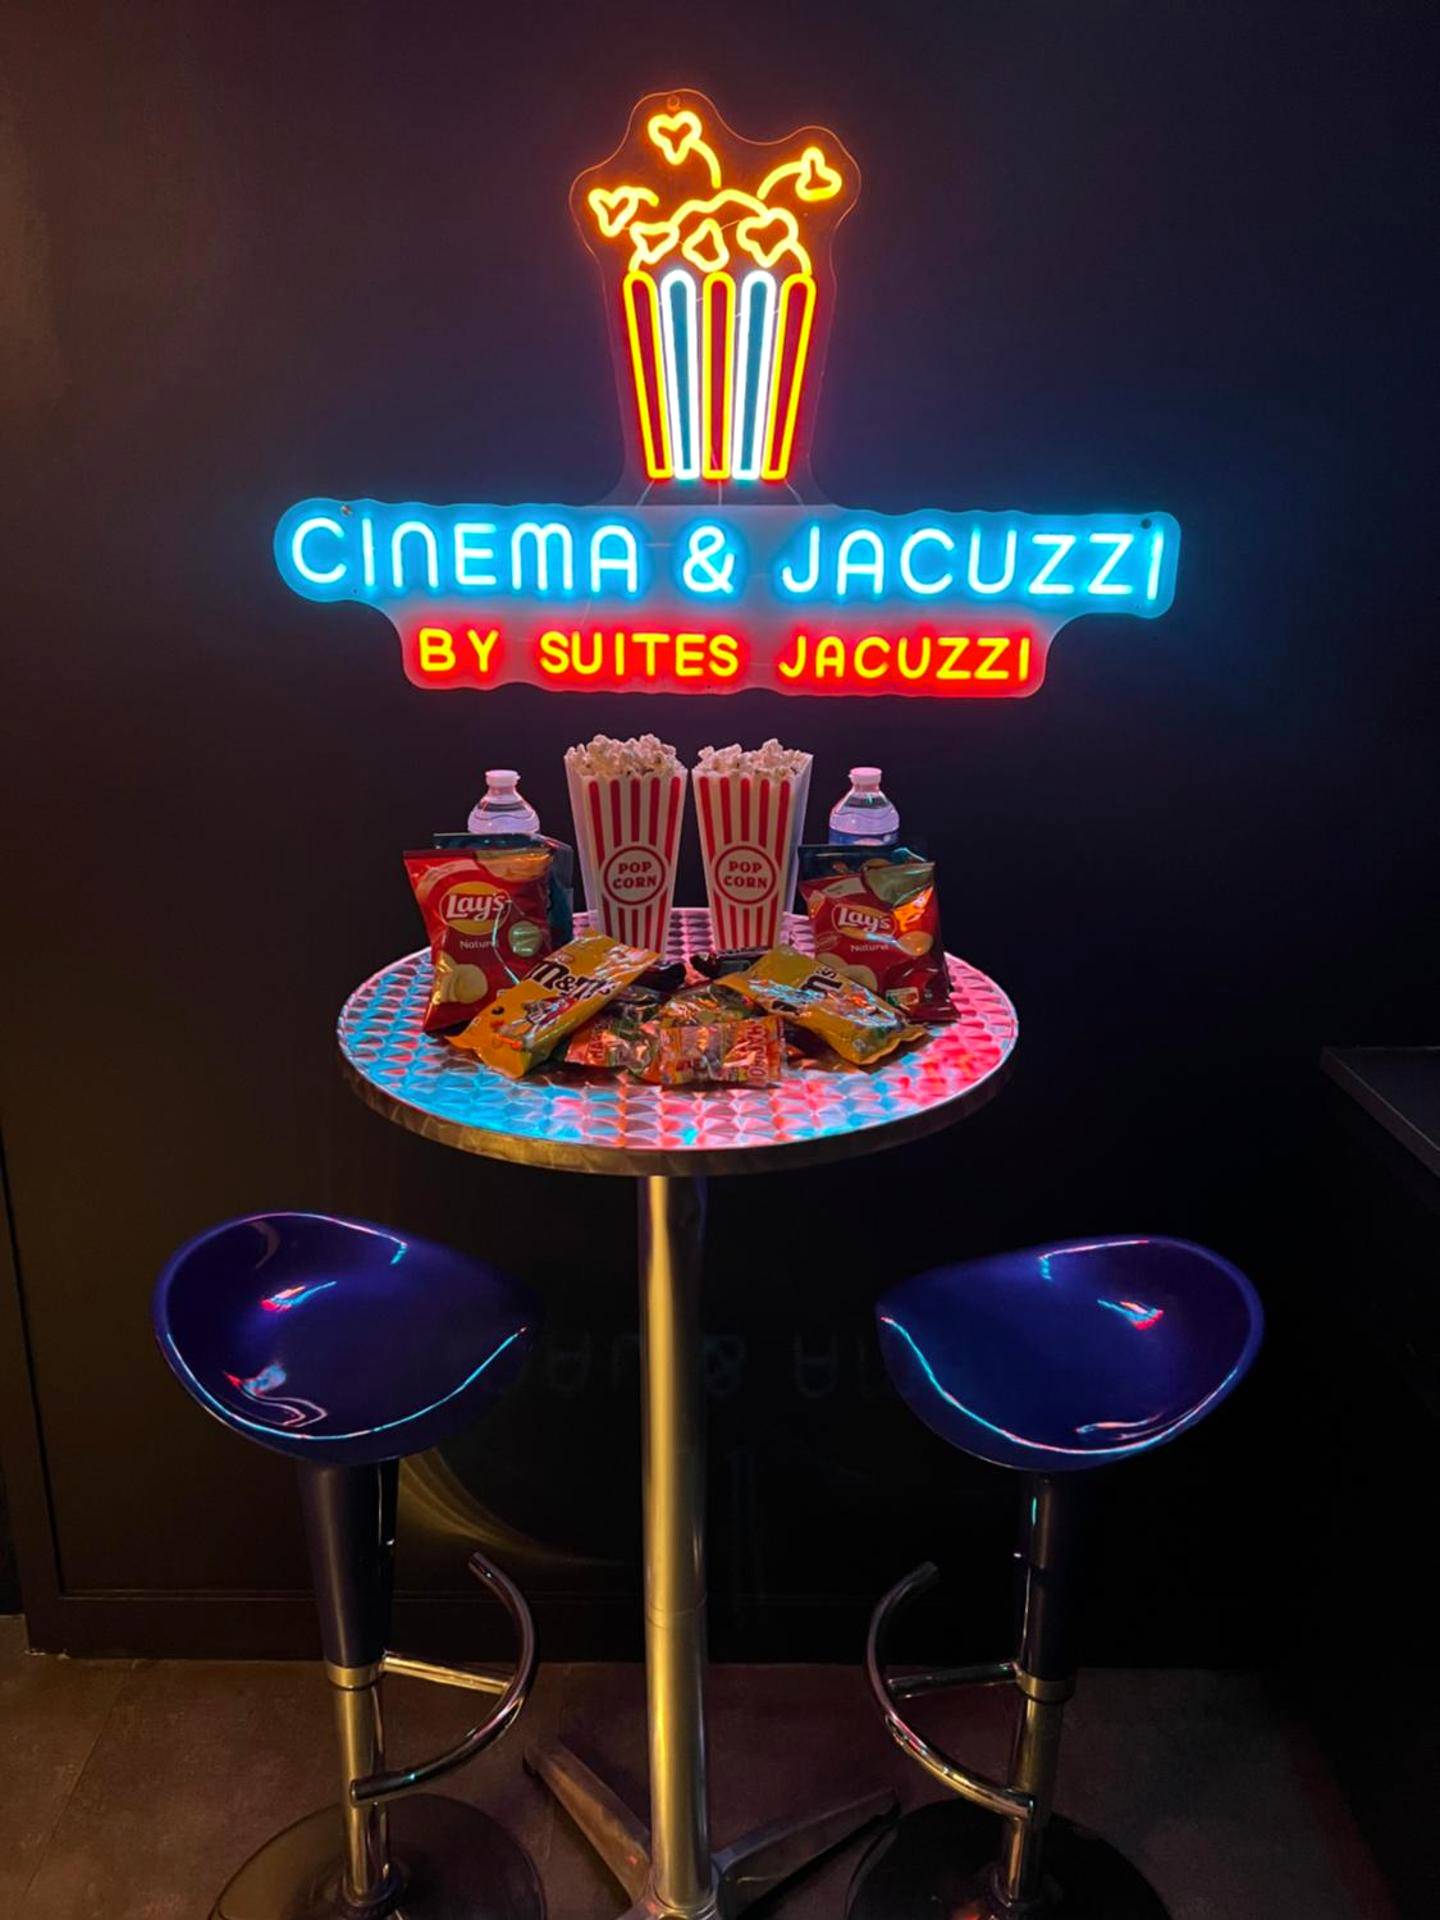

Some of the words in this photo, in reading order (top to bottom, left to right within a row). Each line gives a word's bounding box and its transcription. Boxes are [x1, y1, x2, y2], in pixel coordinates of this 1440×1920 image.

[290, 516, 638, 593] CINEMA
[682, 524, 736, 594] &
[781, 524, 1165, 601] JACUZZI
[418, 626, 500, 673] BY
[539, 631, 739, 677] SUITES
[778, 634, 1031, 682] JACUZZI
[617, 861, 653, 875] POP
[728, 860, 763, 874] POP
[612, 876, 657, 890] CORN
[723, 875, 768, 889] CORN
[446, 893, 505, 922] Lay's
[837, 907, 891, 933] Lay's
